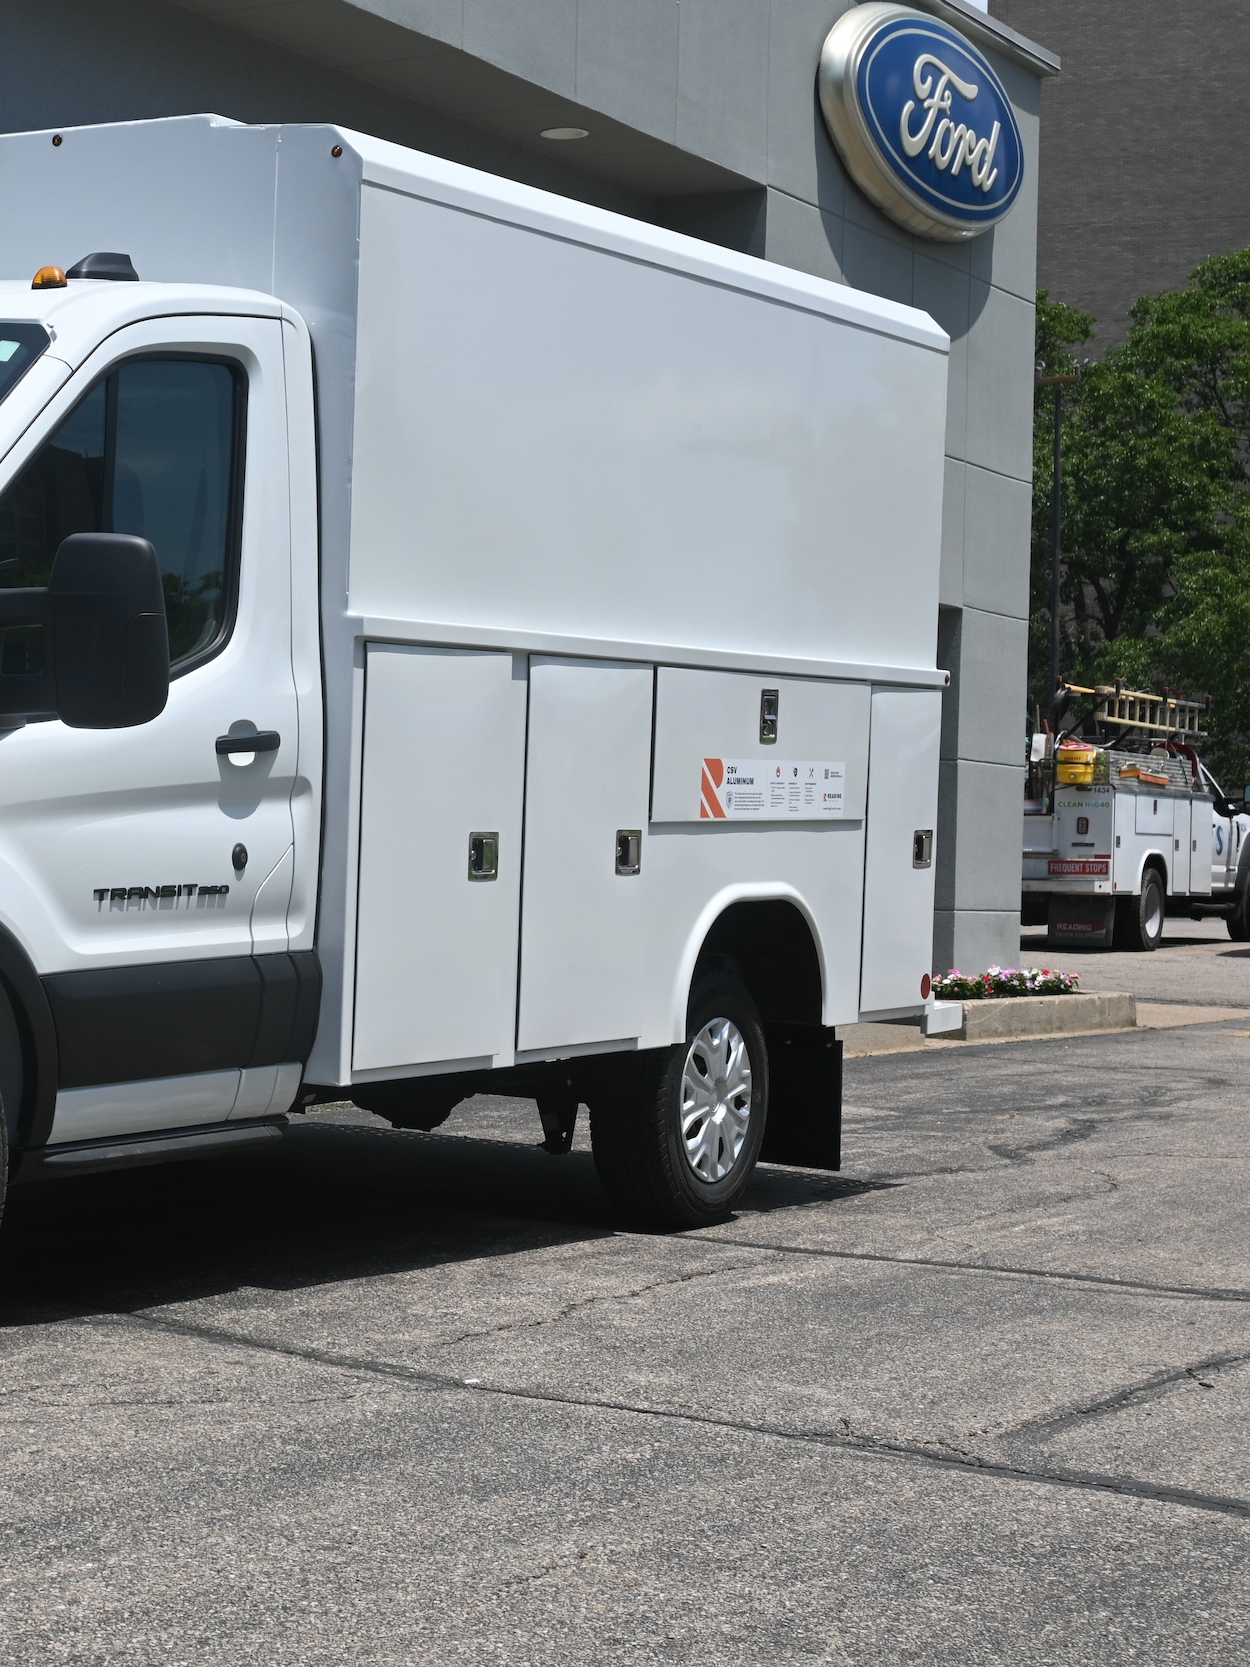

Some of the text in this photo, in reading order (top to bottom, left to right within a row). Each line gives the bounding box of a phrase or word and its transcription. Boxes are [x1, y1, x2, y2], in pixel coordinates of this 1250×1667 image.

[901, 53, 1000, 192] Ford
[726, 766, 738, 774] CSV
[726, 777, 754, 785] ALUMINUM
[1050, 862, 1107, 873] FREQUENT STOPS
[93, 883, 198, 902] TRANSIT
[1056, 923, 1092, 931] READING
